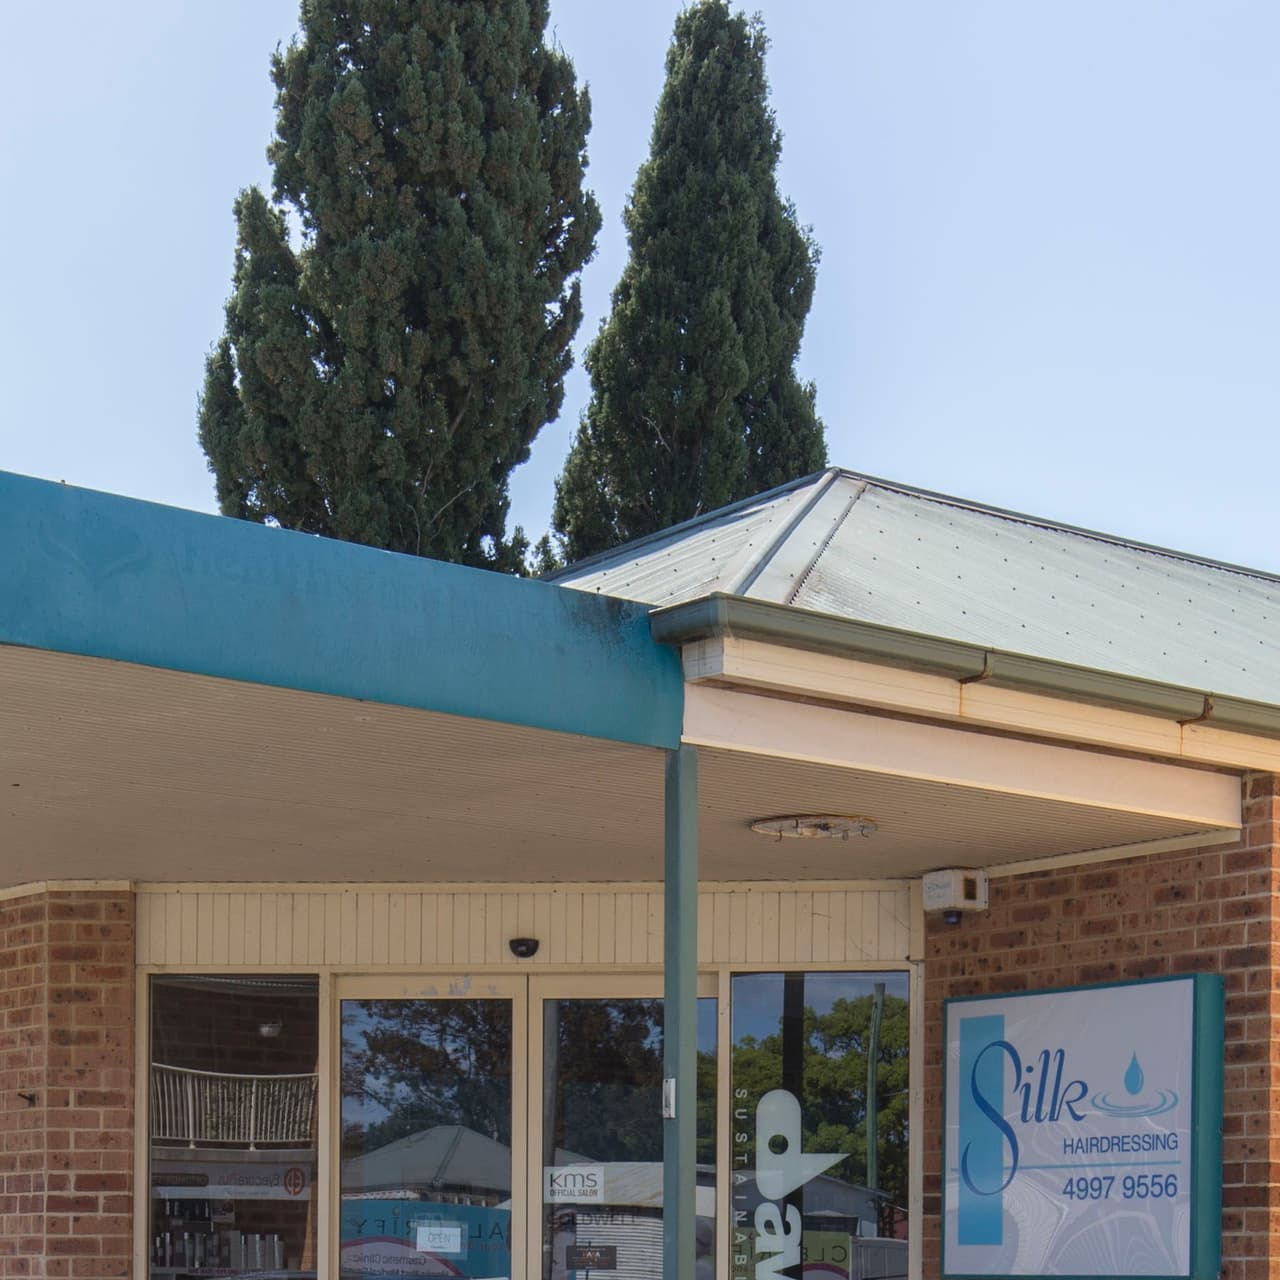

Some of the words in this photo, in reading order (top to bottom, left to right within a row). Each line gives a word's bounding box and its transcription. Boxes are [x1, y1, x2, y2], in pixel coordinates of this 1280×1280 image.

[960, 1039, 1089, 1197] Silk
[1062, 1132, 1179, 1155] HAIRDRESSING
[549, 1172, 598, 1188] kms
[1062, 1174, 1116, 1201] 4997
[1122, 1173, 1178, 1200] 9556
[549, 1188, 576, 1197] OFFICIAL
[577, 1188, 599, 1198] SALON
